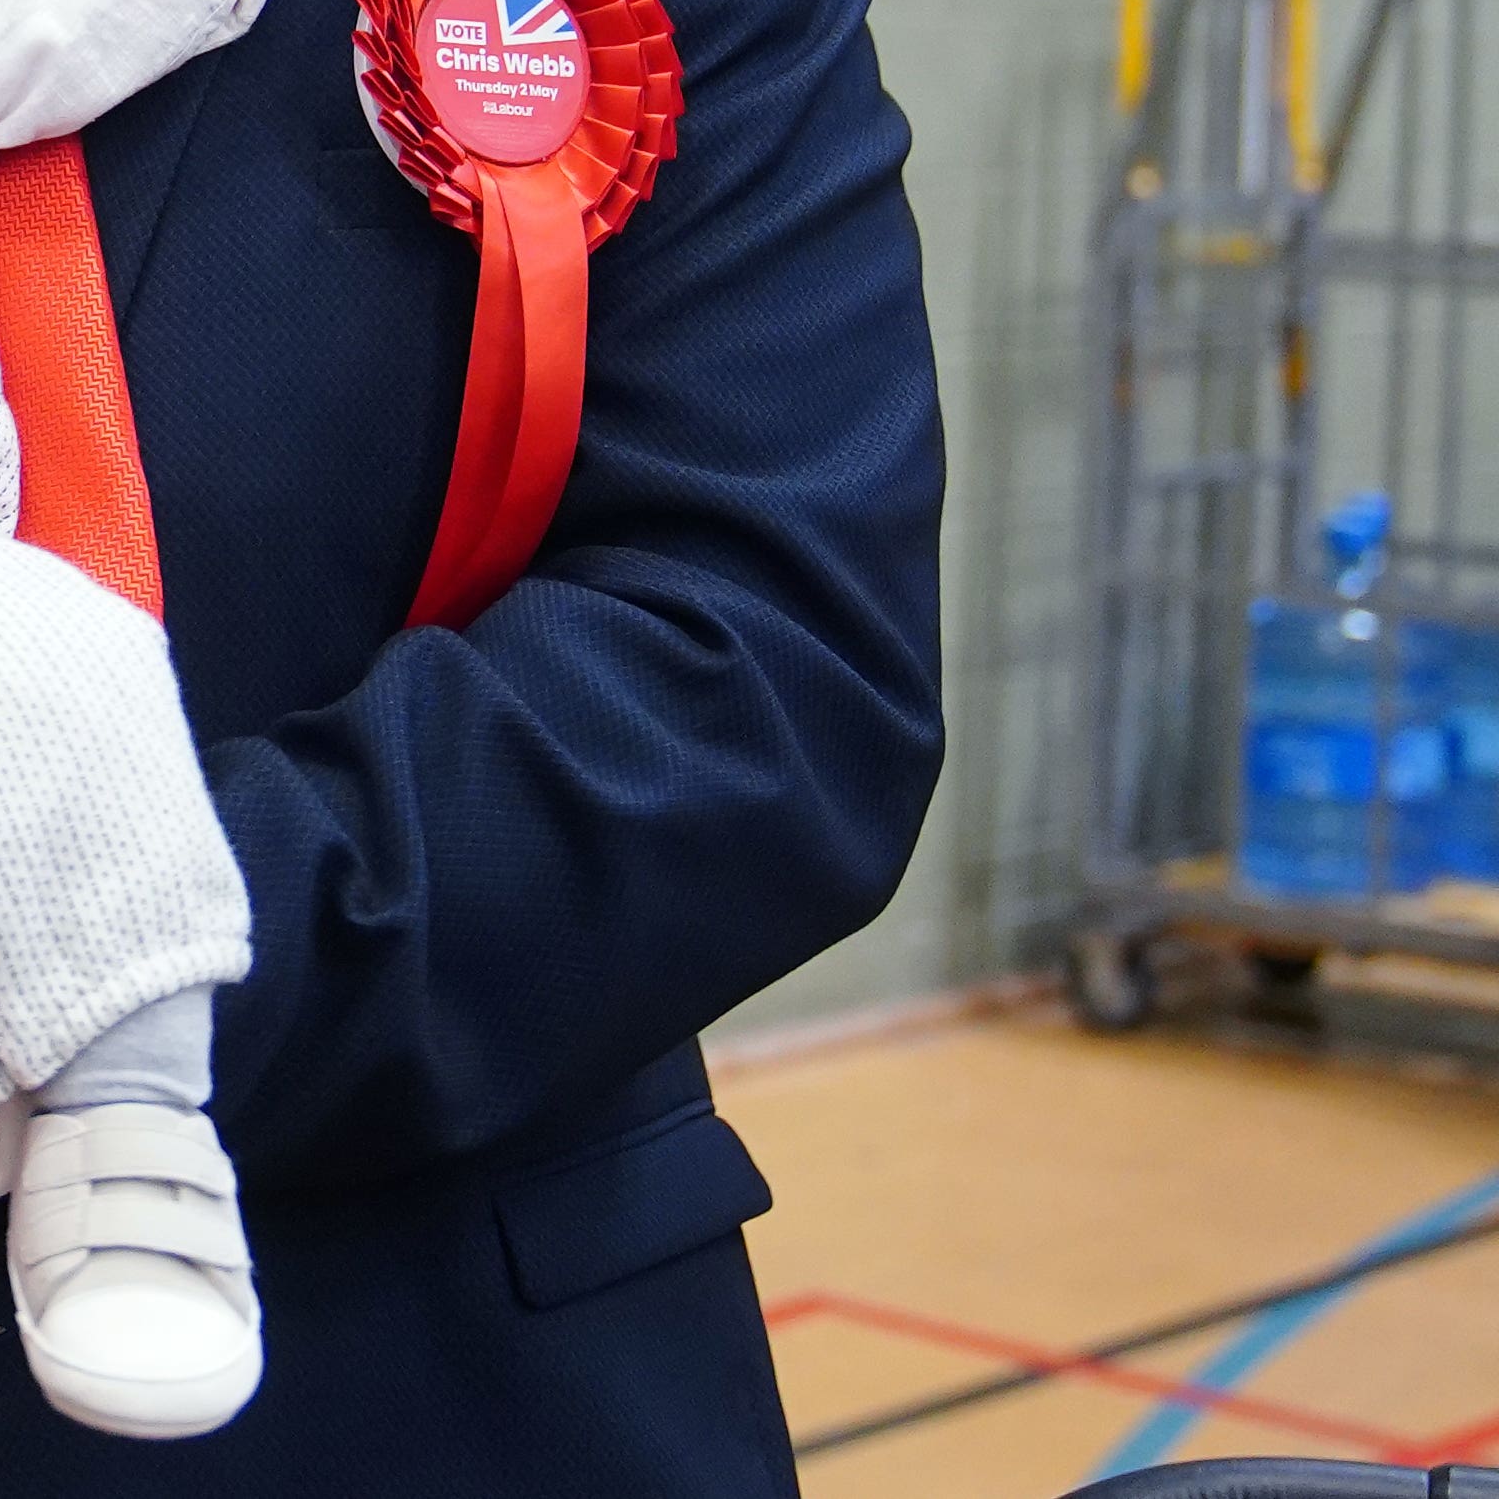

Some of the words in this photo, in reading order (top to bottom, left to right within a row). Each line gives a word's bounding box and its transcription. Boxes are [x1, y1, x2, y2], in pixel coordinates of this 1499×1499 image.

[439, 22, 483, 40] VOTE
[436, 48, 500, 72] Chris
[503, 52, 576, 77] Webb
[455, 79, 518, 99] Thursday
[519, 83, 528, 96] 2
[529, 84, 558, 101] May
[493, 103, 534, 116] Labour
